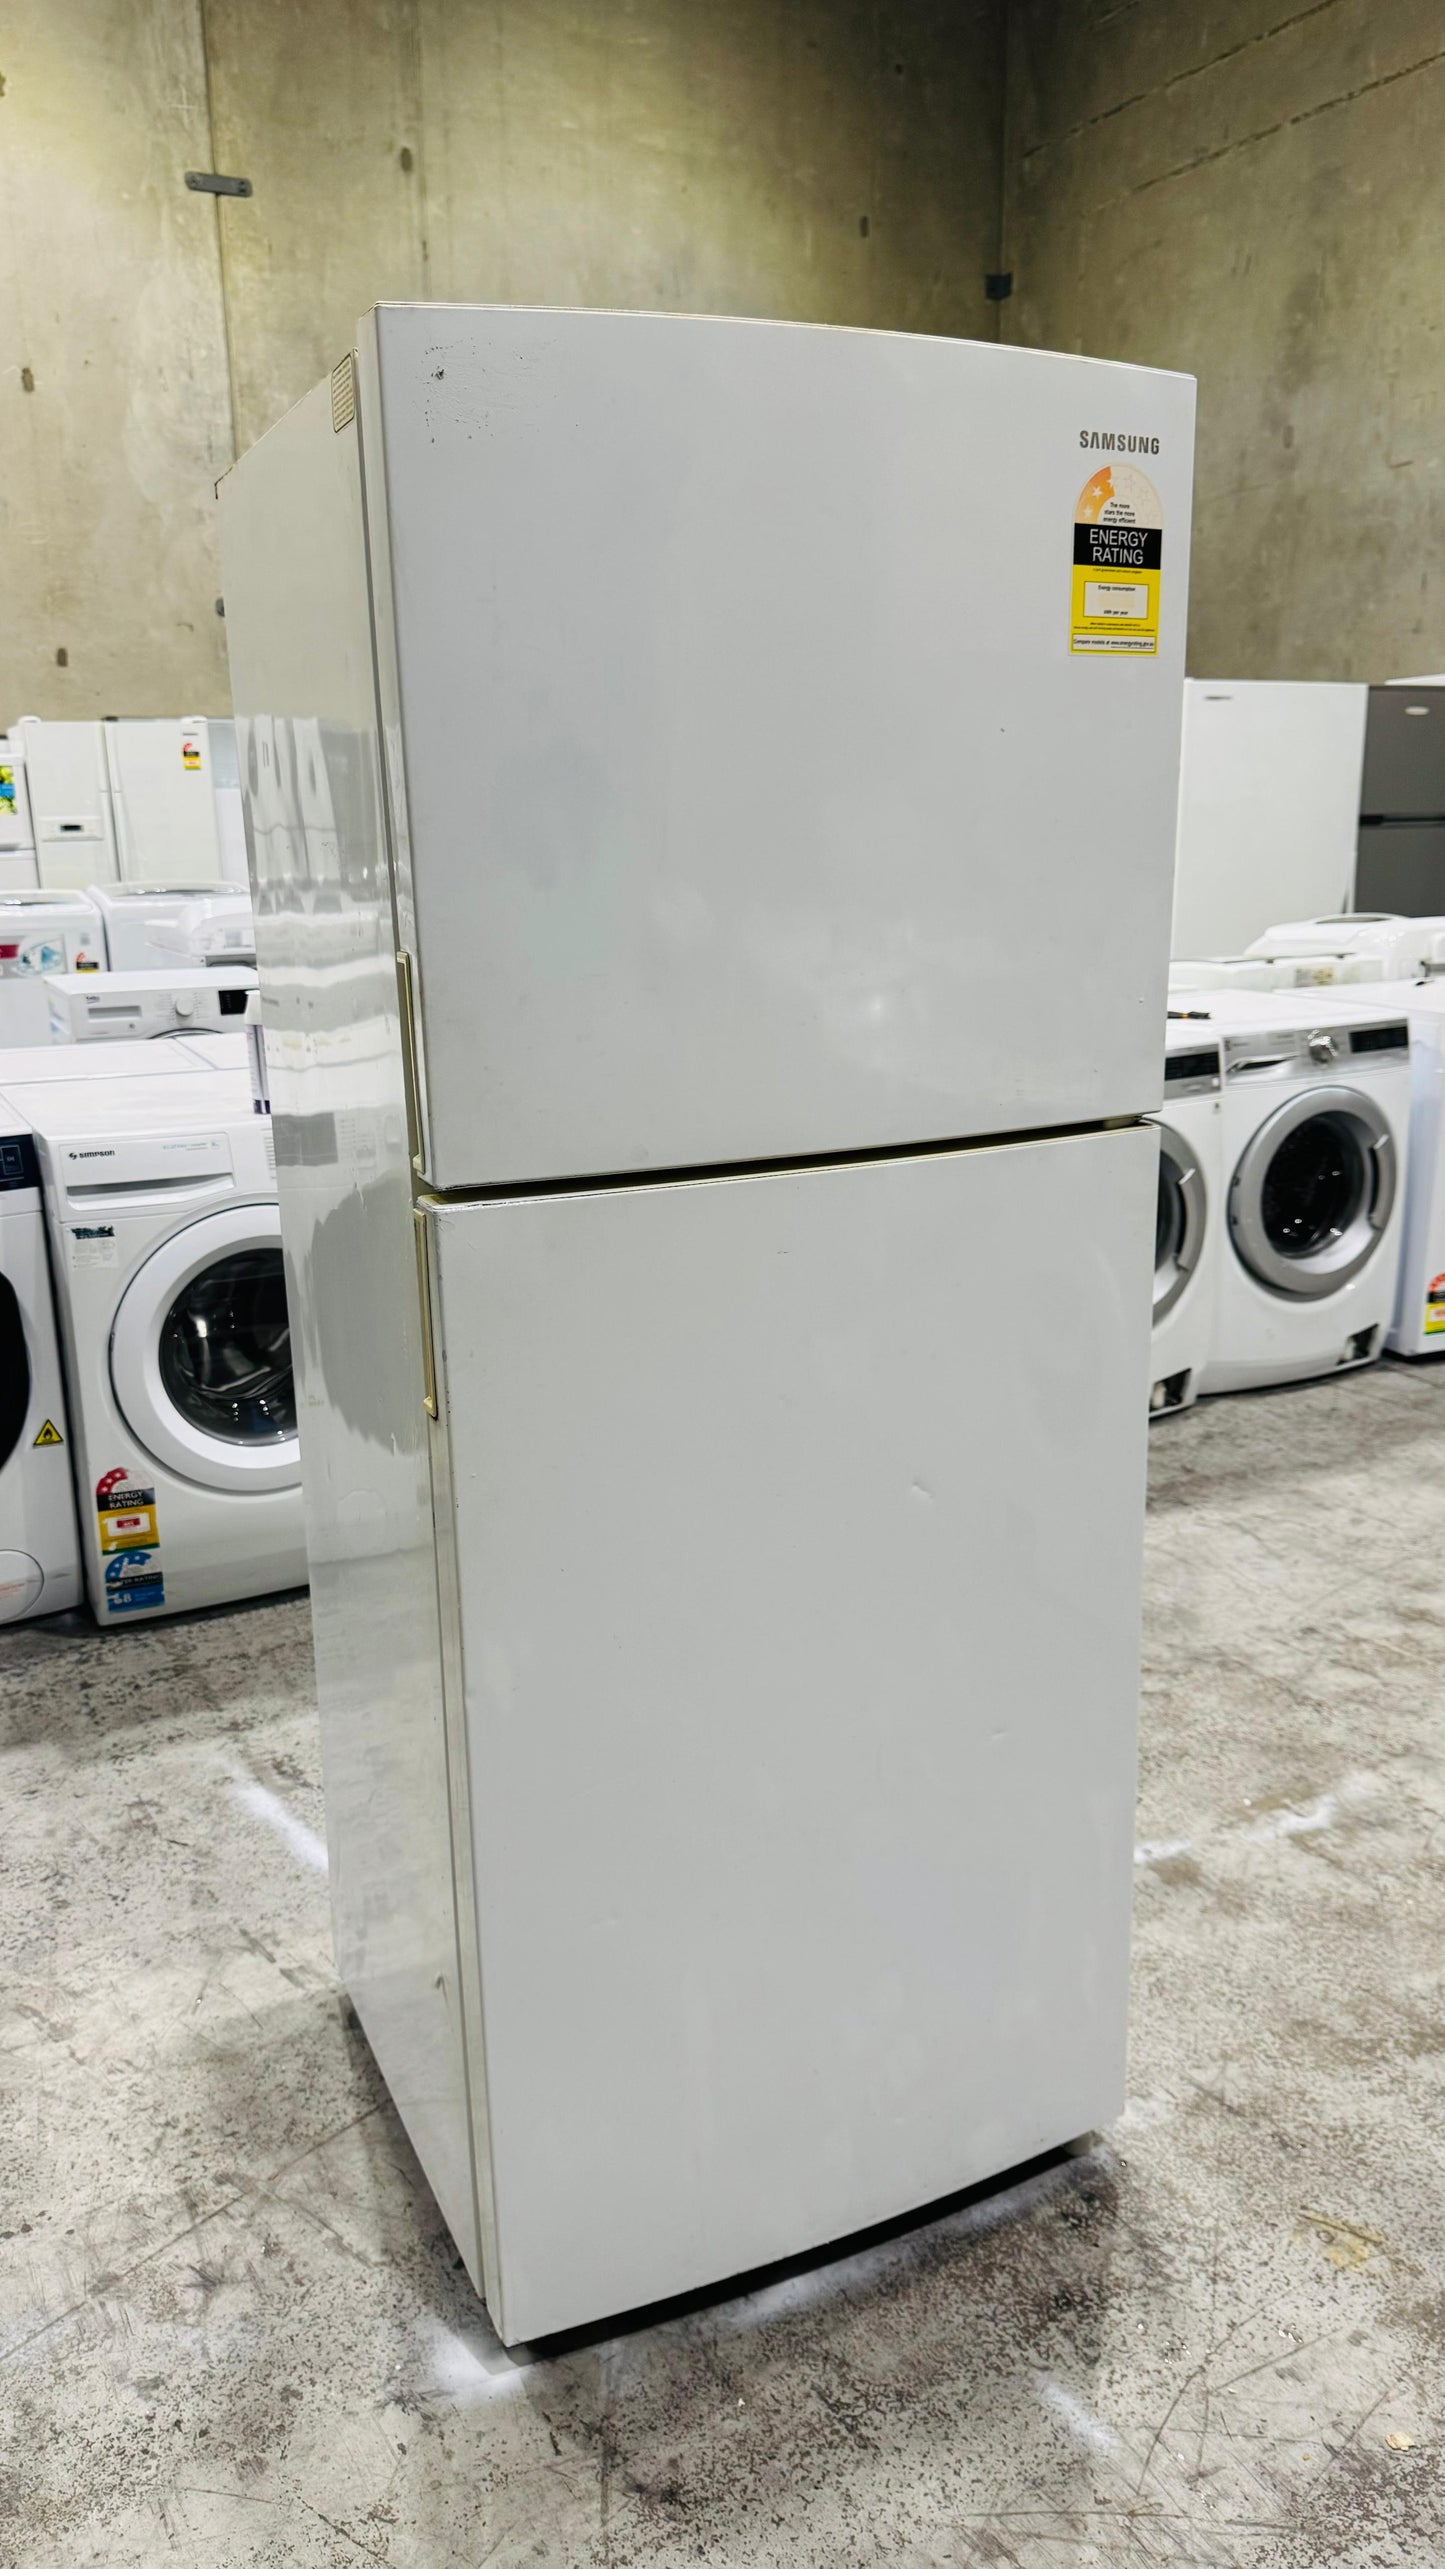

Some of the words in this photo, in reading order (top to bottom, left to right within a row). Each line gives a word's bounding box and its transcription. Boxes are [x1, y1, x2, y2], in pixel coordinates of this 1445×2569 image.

[1080, 430, 1159, 455] SAMSUNG
[1089, 528, 1148, 548] ENERGY
[1092, 546, 1144, 565] RATING
[108, 1491, 144, 1500] ENERGY
[109, 1500, 144, 1509] RATING
